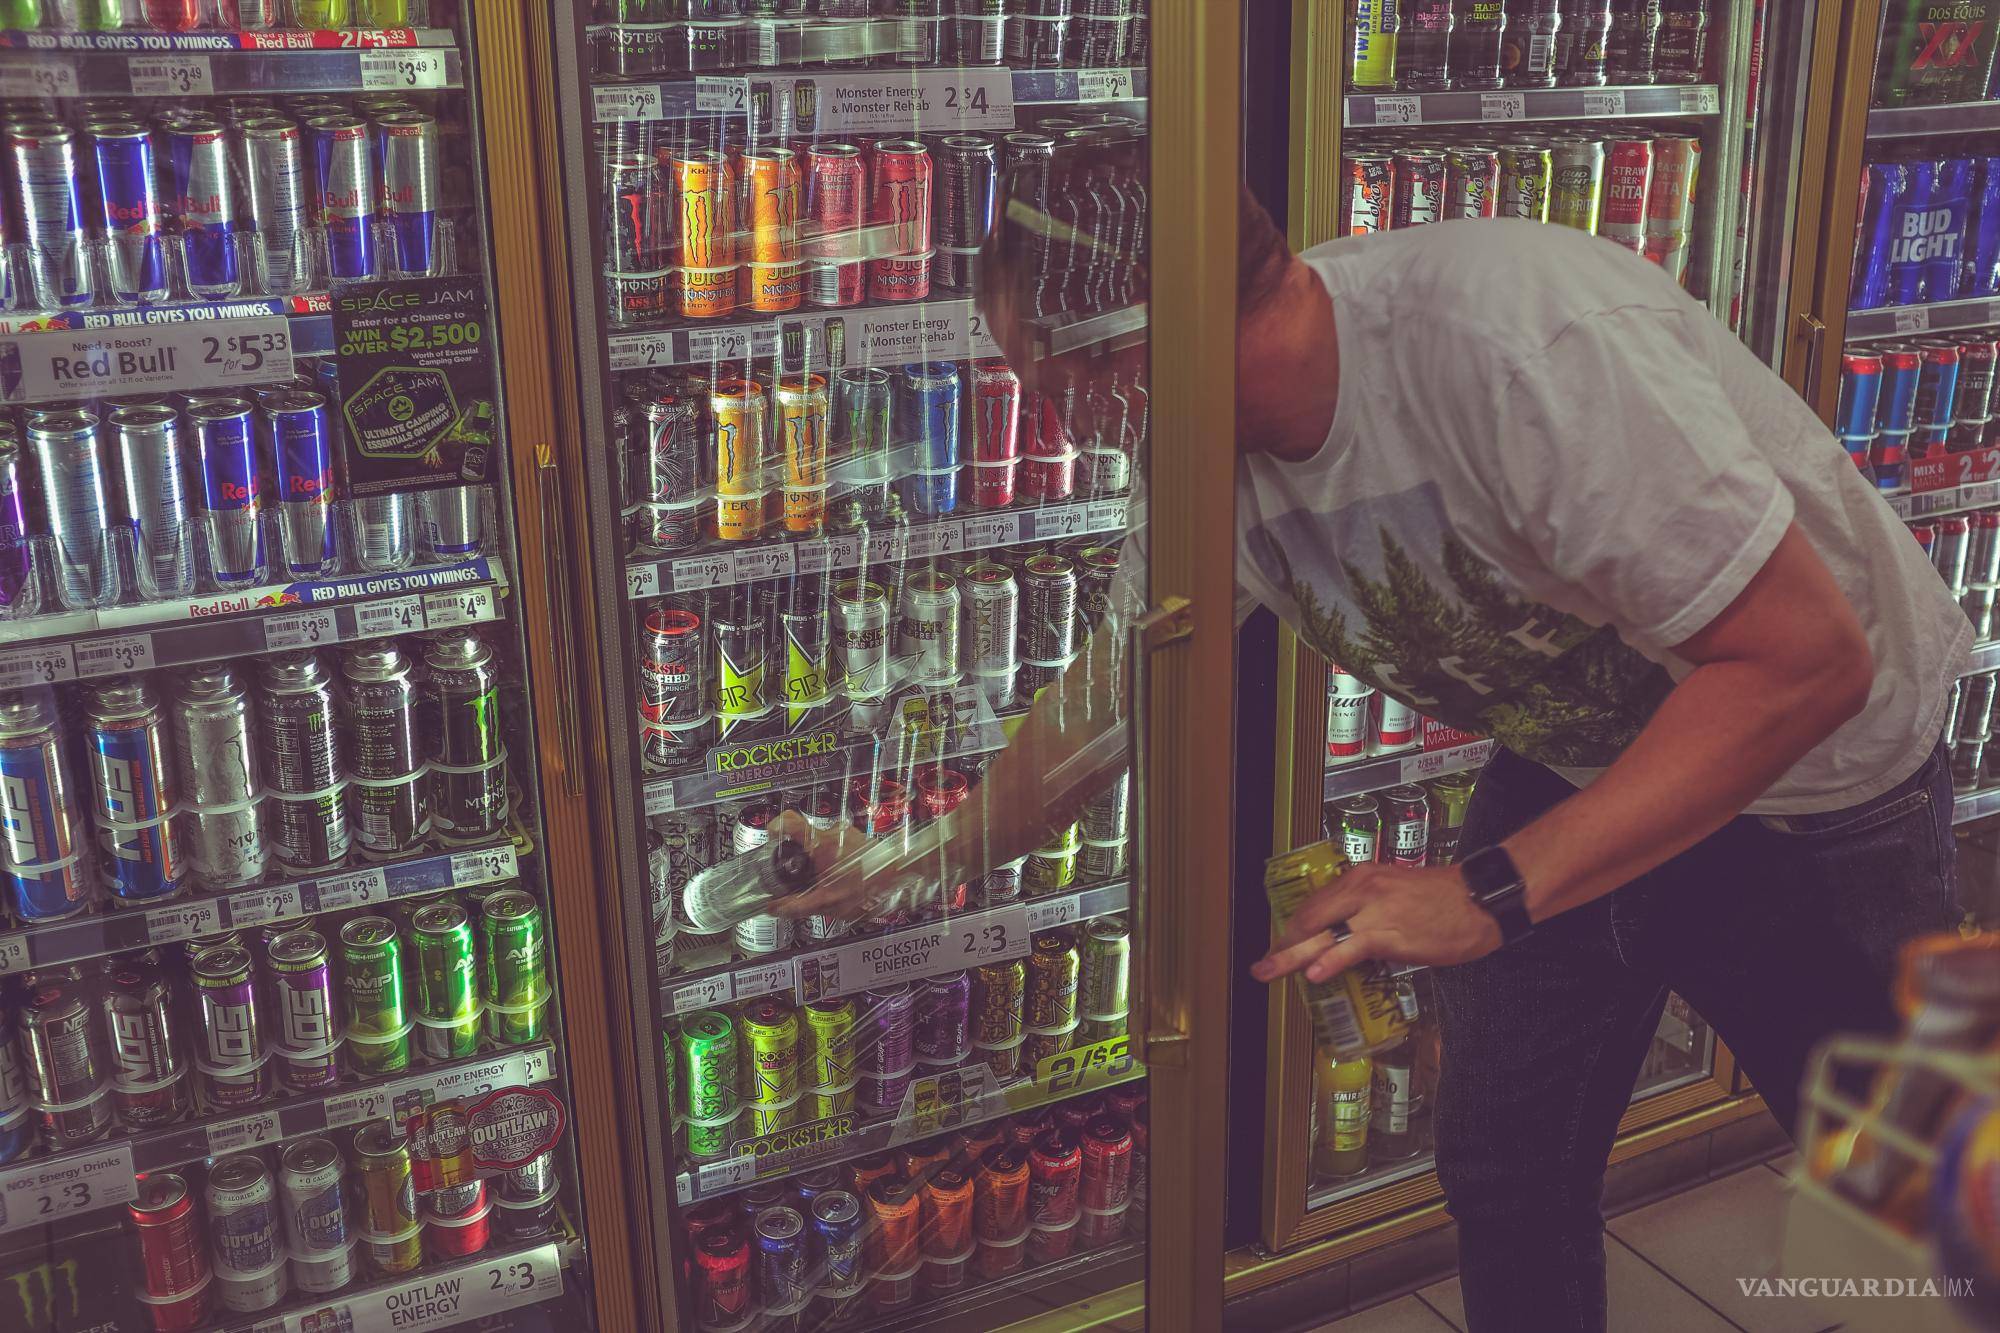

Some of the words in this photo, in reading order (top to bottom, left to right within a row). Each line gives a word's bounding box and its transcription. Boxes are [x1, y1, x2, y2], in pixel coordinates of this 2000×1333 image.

[1927, 7, 1950, 20] DOS
[26, 35, 56, 48] RED
[60, 35, 95, 48] BULL
[96, 35, 137, 49] GIVES
[139, 35, 170, 48] YOU
[256, 37, 284, 48] Red
[287, 36, 314, 48] Bull
[835, 87, 880, 99] Monster
[886, 86, 926, 101] Energy
[944, 86, 958, 108] 2
[832, 105, 839, 113] &
[842, 102, 890, 113] Monster
[894, 99, 930, 112] Rehab
[1613, 166, 1646, 176] STRAW
[1610, 185, 1643, 199] RITA
[1902, 208, 1952, 238] BUD
[1890, 232, 1958, 263] LIGHT
[680, 271, 734, 286] JUICE
[427, 289, 474, 304] JAM
[84, 314, 110, 329] RED
[113, 311, 145, 326] BULL
[148, 309, 184, 325] GIVES
[186, 307, 215, 322] YOU
[352, 318, 381, 328] Enter
[383, 316, 399, 326] for
[410, 311, 452, 323] Chance
[454, 311, 465, 319] to
[864, 319, 910, 334] Monster
[912, 317, 950, 333] Energy
[345, 328, 381, 343] WIN
[390, 321, 481, 351] $2,500
[860, 340, 867, 348] &
[869, 333, 917, 347] Monster
[919, 331, 955, 345] Rehab
[968, 316, 982, 336] 2
[72, 341, 102, 352] Need
[114, 337, 153, 348] Boost?
[340, 340, 389, 356] OVER
[51, 352, 111, 382] Red
[117, 346, 176, 376] Bull
[202, 335, 223, 364] 2
[363, 422, 405, 439] ULTIMATE
[406, 402, 446, 430] CAMPING
[1913, 464, 1936, 477] MIX
[1959, 454, 1973, 482] 2
[189, 600, 220, 618] Red
[221, 597, 250, 612] Bull
[311, 586, 335, 601] RED
[338, 583, 365, 598] BULL
[366, 578, 401, 595] GIVES
[402, 575, 428, 589] YOU
[727, 766, 778, 784] ENERGY
[786, 755, 829, 771] DRINK
[862, 934, 940, 963] ROCKSTAR
[963, 932, 977, 953] 2
[874, 950, 931, 974] ENERGY
[344, 973, 393, 988] AMP
[436, 1074, 461, 1088] AMP
[464, 1063, 507, 1082] ENERGY
[428, 1125, 466, 1144] OUTLAW
[473, 1110, 549, 1144] OUTLAW
[492, 1131, 539, 1150] ENERGY
[6, 1179, 35, 1192] NOS
[39, 1166, 81, 1185] Energy
[83, 1157, 121, 1173] Drinks
[38, 1196, 55, 1215] 2
[385, 1277, 462, 1311] OUTLAW
[488, 1269, 504, 1290] 2
[391, 1295, 461, 1327] ENERGY
